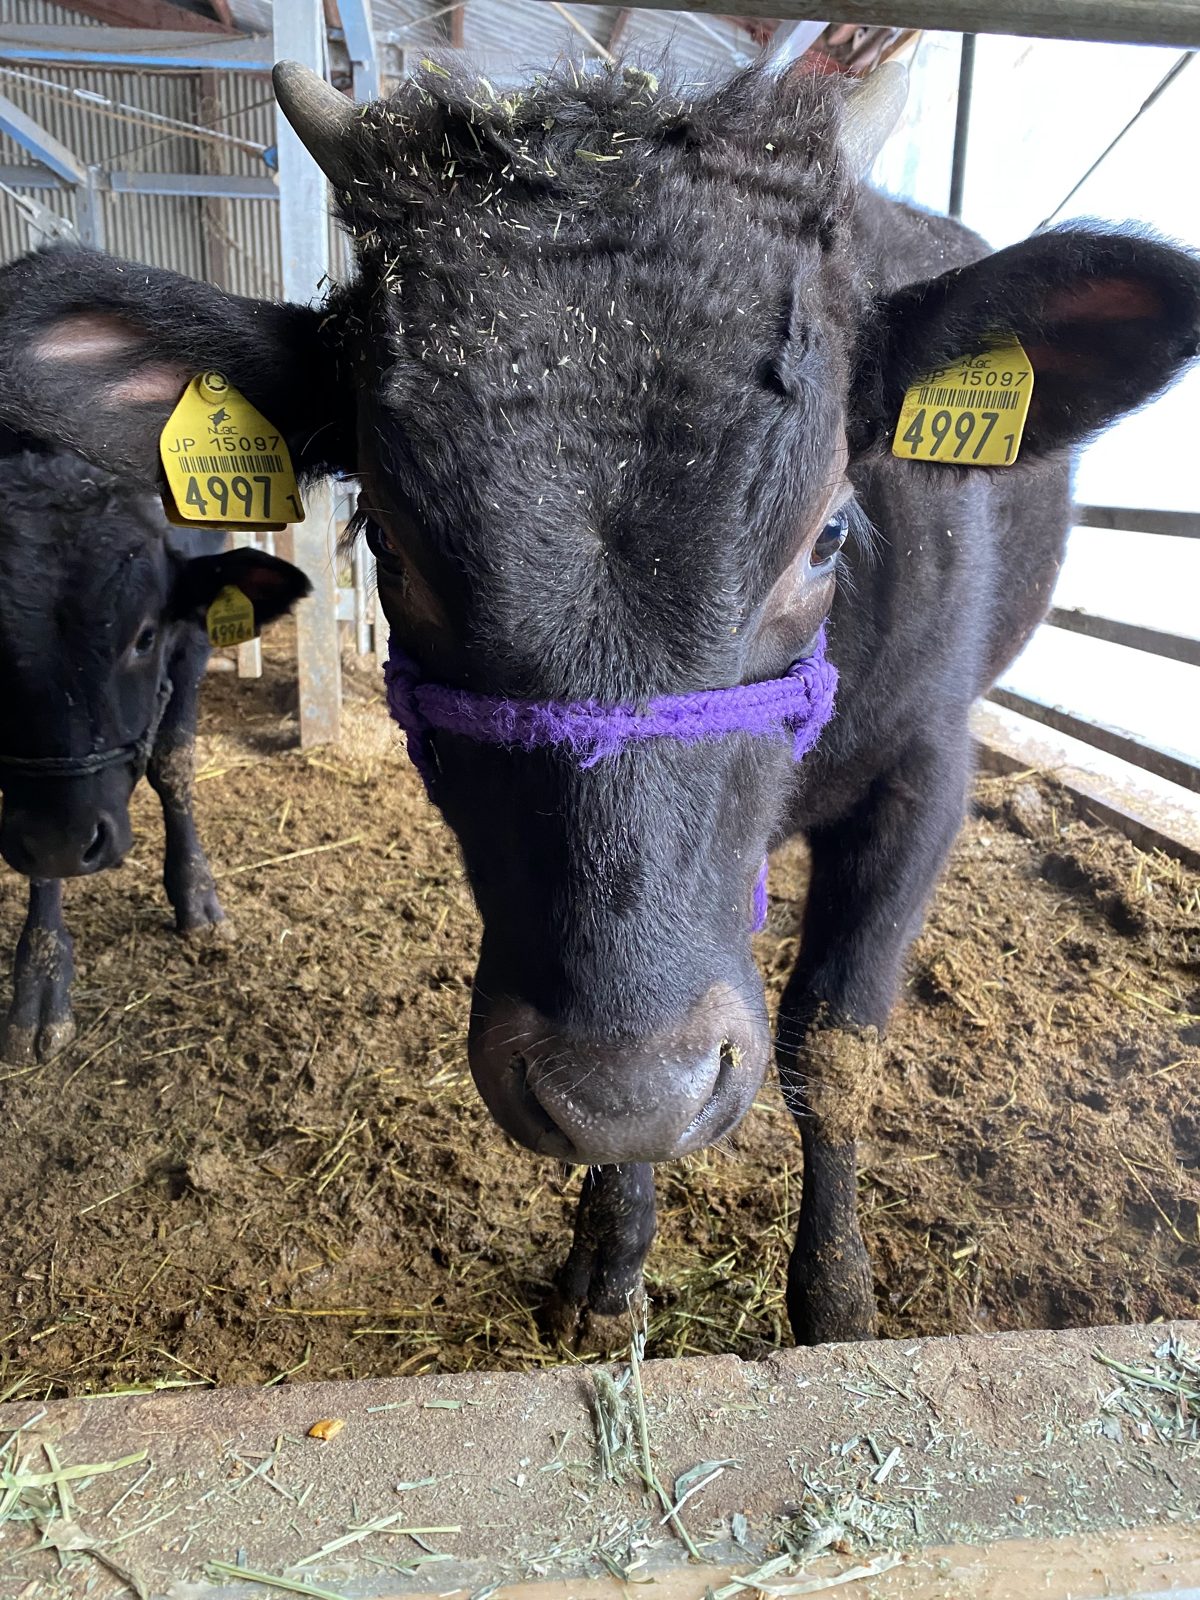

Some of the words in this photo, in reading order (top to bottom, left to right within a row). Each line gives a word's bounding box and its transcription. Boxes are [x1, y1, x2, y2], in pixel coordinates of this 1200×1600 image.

[958, 371, 1029, 387] 15097
[168, 438, 195, 453] JP
[209, 436, 280, 452] 15097
[903, 408, 999, 460] 4997
[1004, 434, 1015, 461] 1
[186, 476, 271, 518] 4997
[286, 494, 304, 519] 1
